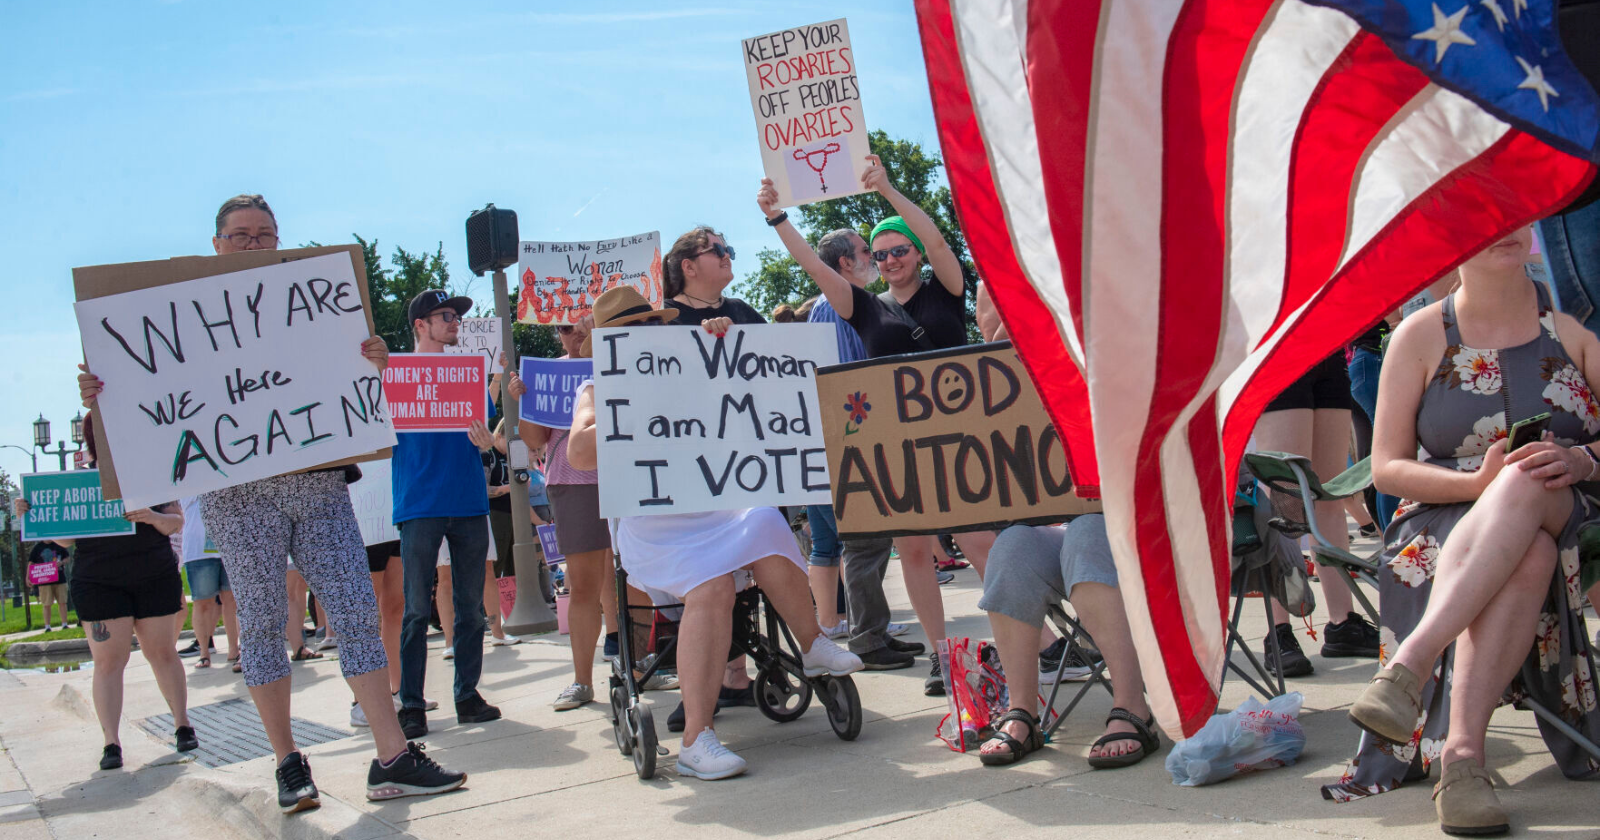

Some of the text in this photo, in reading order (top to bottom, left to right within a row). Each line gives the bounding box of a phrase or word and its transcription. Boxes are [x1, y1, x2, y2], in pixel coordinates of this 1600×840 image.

[745, 24, 842, 64] KEEP YOUR
[757, 48, 851, 90] ROSARIES
[759, 89, 790, 118] OFF
[764, 106, 853, 150] OVARIES
[524, 243, 544, 253] Hell
[551, 244, 574, 253] Hath
[596, 241, 617, 253] Fury
[621, 237, 643, 248] Like
[567, 253, 623, 276] Woman
[436, 291, 449, 304] H
[101, 278, 363, 374] WHY ARE
[462, 320, 496, 333] FORCE
[475, 335, 488, 347] TO
[601, 329, 817, 381] I am Woman
[437, 366, 480, 383] RIGHTS
[534, 373, 594, 393] MY UT
[139, 368, 292, 426] WE Here
[416, 384, 438, 400] ARE
[894, 354, 1023, 423] BOD
[430, 401, 473, 418] RIGHTS
[536, 394, 575, 414] MY C
[605, 391, 811, 442] I am Mad
[634, 448, 830, 506] I VOTE
[835, 421, 1100, 521] AUTONO
[31, 487, 102, 506] KEEP ABORT
[29, 506, 59, 523] SAFE
[63, 505, 88, 522] AND
